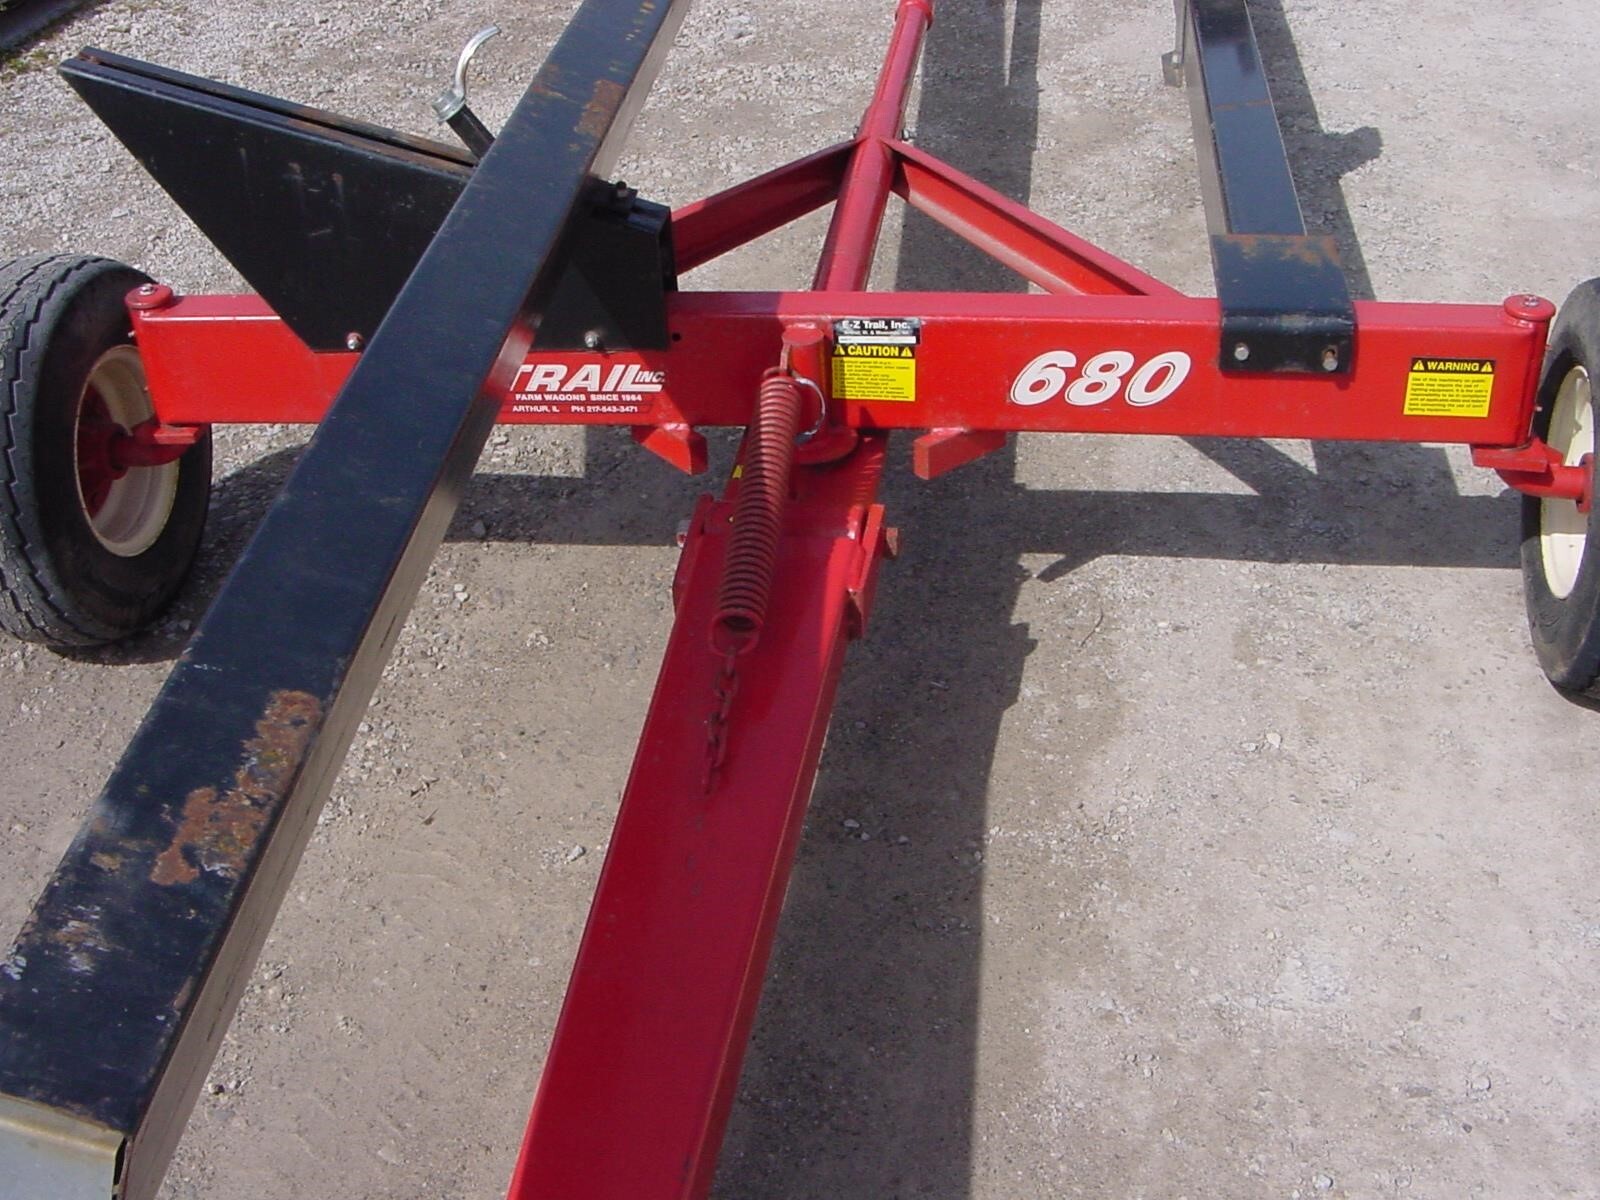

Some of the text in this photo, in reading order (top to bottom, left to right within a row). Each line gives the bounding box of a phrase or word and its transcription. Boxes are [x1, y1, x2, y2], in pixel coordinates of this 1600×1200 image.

[891, 320, 911, 329] Inc.
[847, 345, 899, 356] CAUTION
[1427, 361, 1480, 371] WARNING
[1010, 350, 1191, 406] 680
[515, 393, 542, 401] FARM
[543, 393, 587, 401] WAGONS
